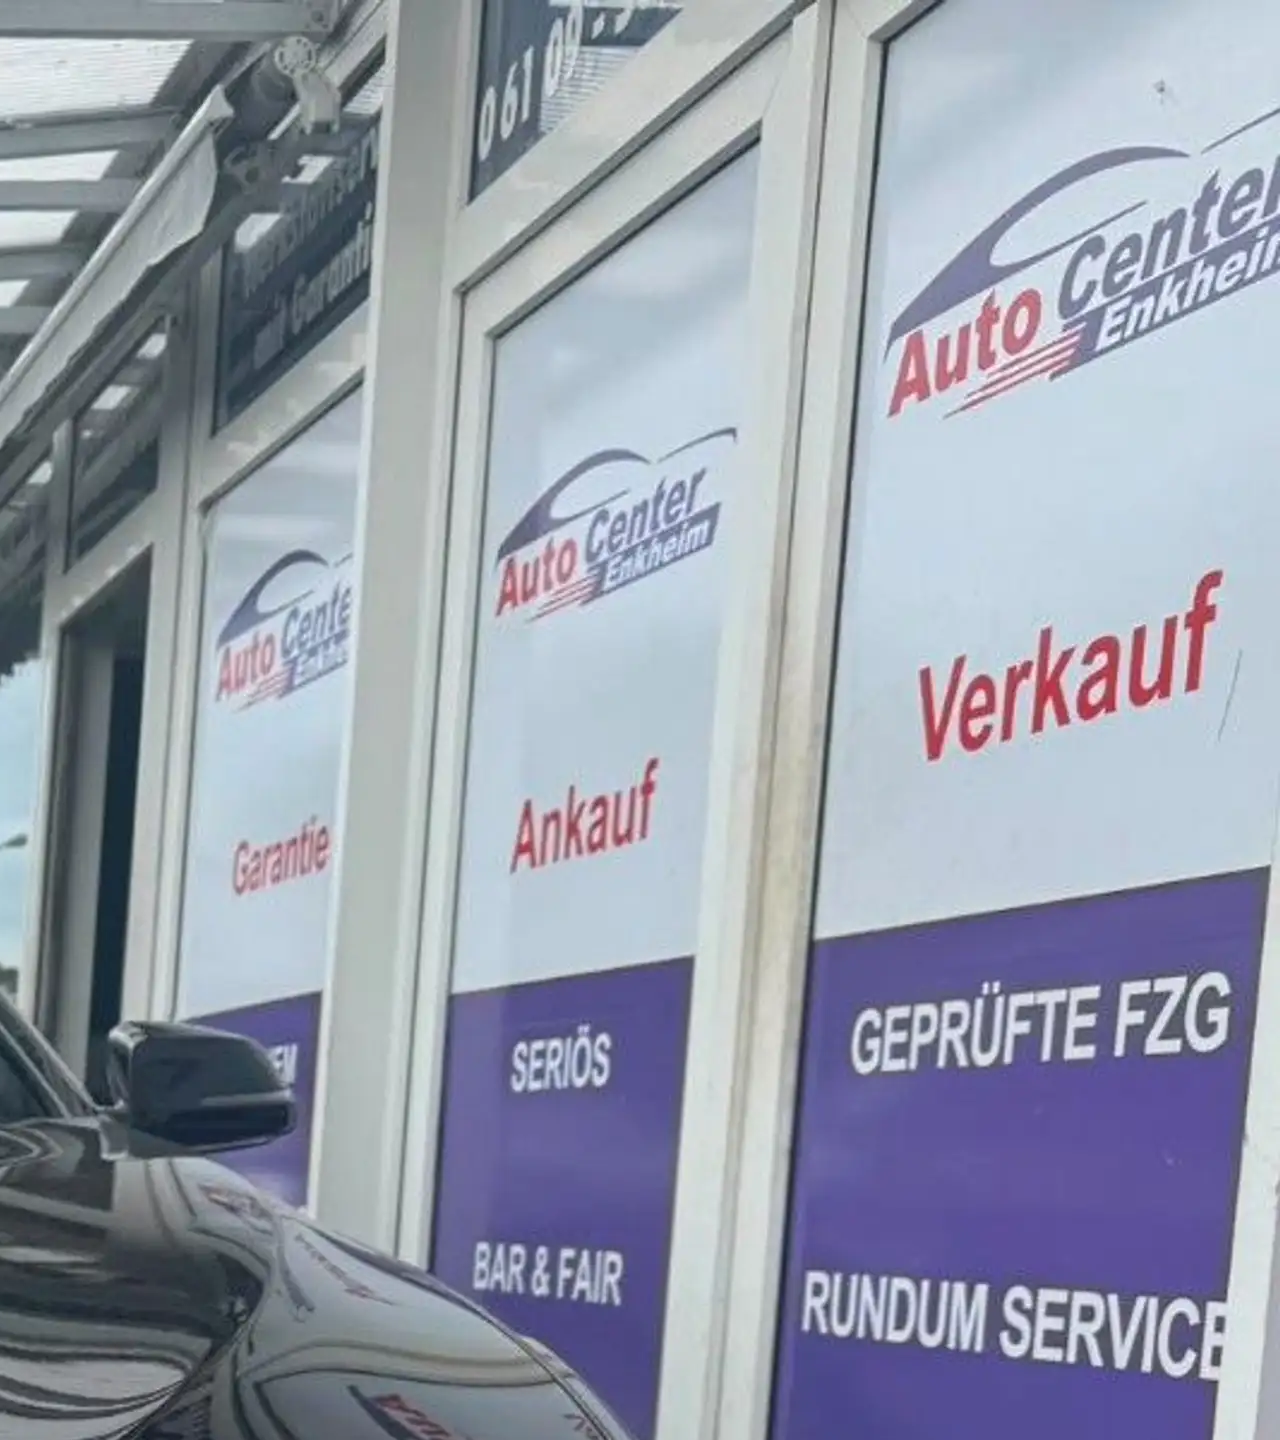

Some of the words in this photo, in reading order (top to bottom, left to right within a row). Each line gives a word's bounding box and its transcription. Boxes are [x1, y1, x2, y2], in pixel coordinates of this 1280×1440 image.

[887, 287, 1042, 418] Auto
[495, 536, 578, 617] Auto
[585, 467, 706, 563] Center
[607, 519, 709, 584] Enkheim
[215, 627, 277, 702] Auto
[280, 584, 353, 659] Cente
[917, 568, 1224, 763] Verkauf
[232, 814, 330, 895] Garantie
[510, 757, 659, 874] Ankauf
[510, 1024, 612, 1093] SERIÖS
[850, 980, 1101, 1075] GEPRÜFTE
[1114, 971, 1232, 1057] FZG
[473, 1241, 526, 1294] BAR
[531, 1246, 550, 1298] &
[557, 1247, 624, 1306] FAIR
[802, 1270, 990, 1354] RUNDUM
